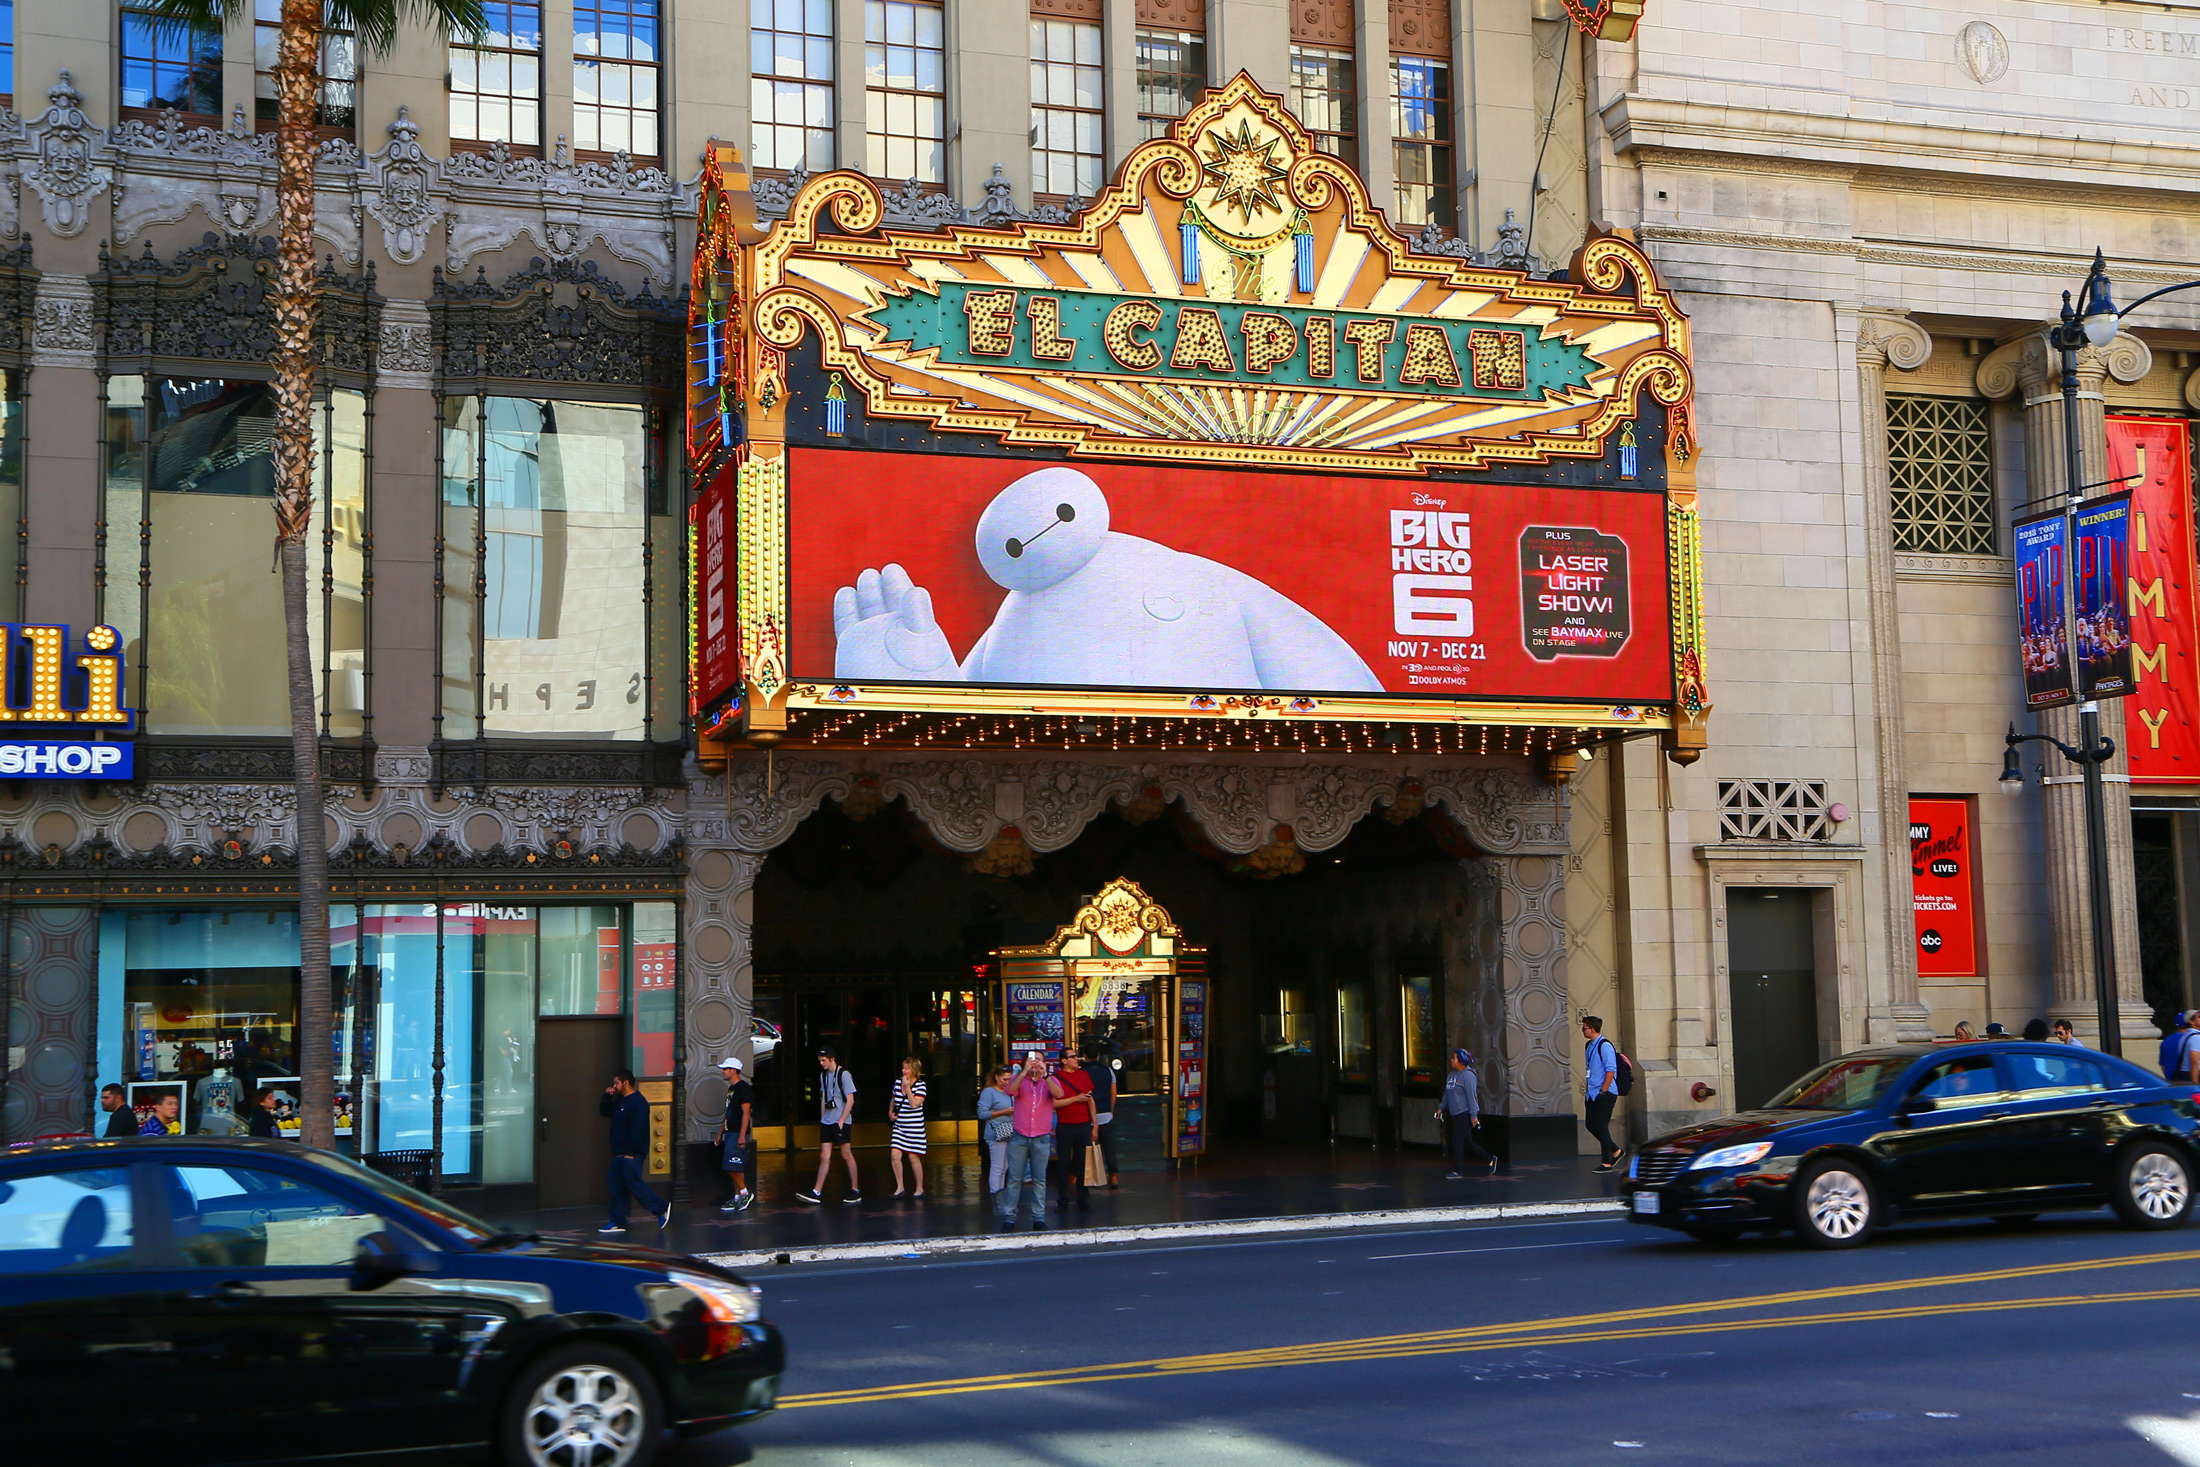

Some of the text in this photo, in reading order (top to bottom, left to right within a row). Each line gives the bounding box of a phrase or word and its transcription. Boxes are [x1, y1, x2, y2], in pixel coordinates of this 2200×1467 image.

[2105, 27, 2198, 54] FREEM
[2130, 87, 2191, 109] AND
[1211, 252, 1280, 300] The
[963, 289, 1527, 392] EL CAPITAN
[1142, 384, 1349, 442] Theatre
[1410, 491, 1447, 510] Disney
[2079, 507, 2127, 527] WINNER!
[1390, 509, 1472, 550] BIG
[1545, 531, 1571, 540] PLUS
[2039, 522, 2061, 534] TONY
[2026, 532, 2055, 546] AWARD
[1391, 547, 1472, 575] HERO
[1539, 554, 1609, 573] LASER
[1548, 573, 1604, 592] LIGHT
[1392, 573, 1474, 638] 6
[1538, 594, 1613, 613] SHOW!
[2126, 446, 2170, 750] JIMMY
[1564, 617, 1585, 625] AND
[1532, 626, 1624, 639] SEE BAYMAX LIVE
[1388, 640, 1418, 658] NOV
[1420, 641, 1429, 658] 7
[1441, 642, 1467, 659] DEC
[1470, 643, 1486, 660] 21
[1532, 638, 1576, 647] ON STAGE
[1442, 676, 1466, 685] ATMOS
[2095, 678, 2124, 691] PANTAGES
[0, 745, 122, 774] SHOP
[1933, 864, 1957, 873] LIVE!
[1920, 934, 1942, 946] abc
[1017, 988, 1054, 1000] CALENDAR
